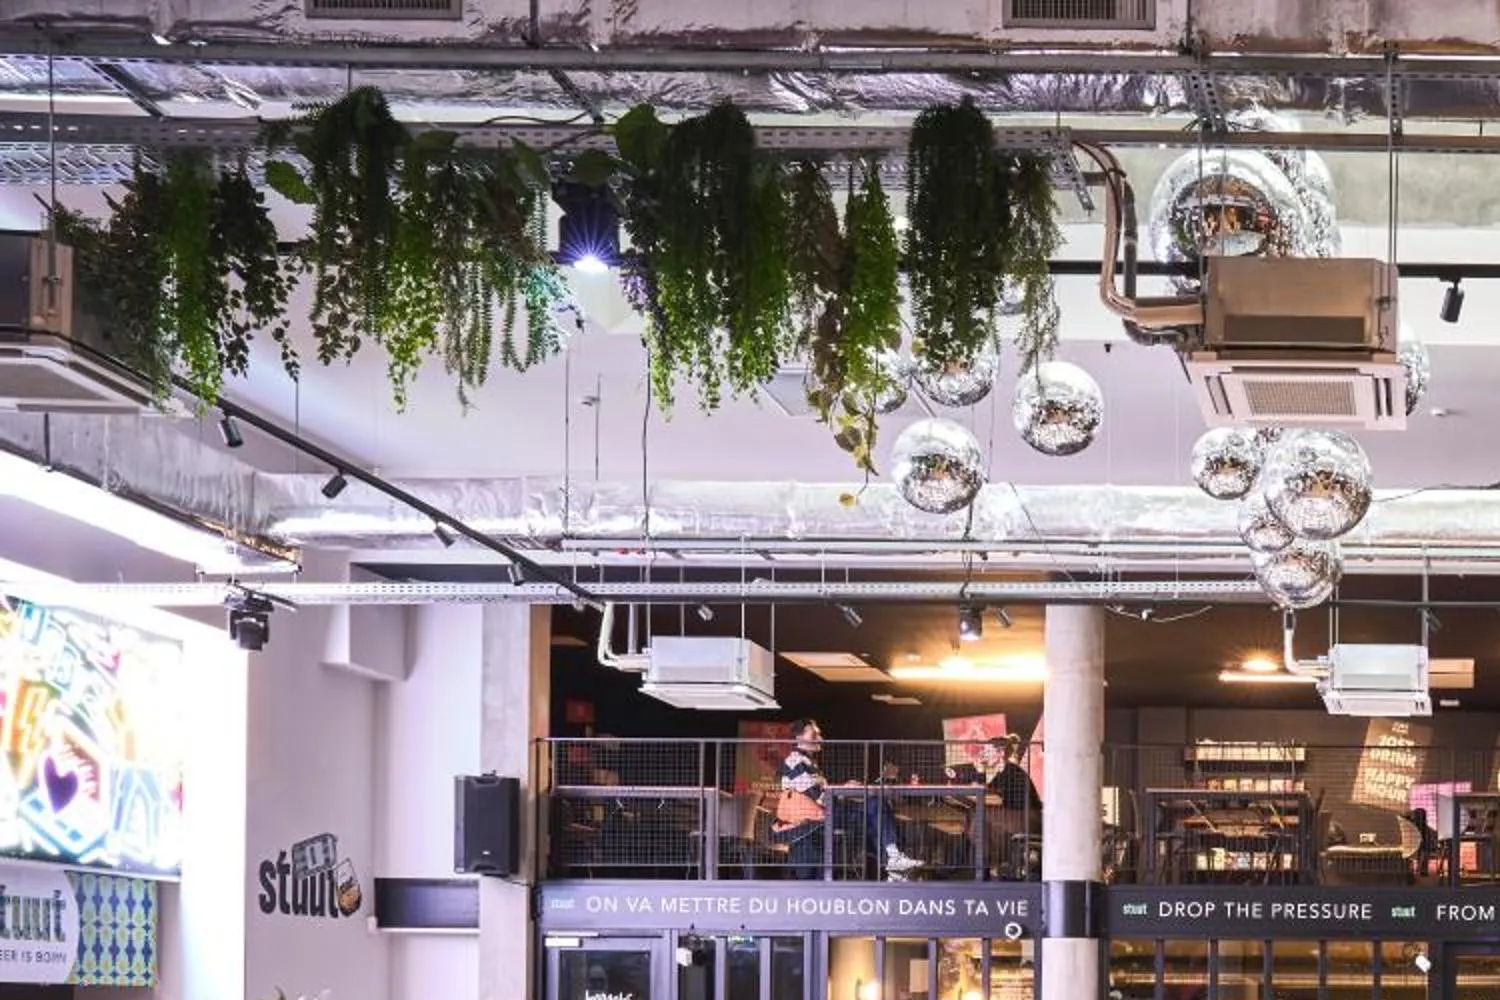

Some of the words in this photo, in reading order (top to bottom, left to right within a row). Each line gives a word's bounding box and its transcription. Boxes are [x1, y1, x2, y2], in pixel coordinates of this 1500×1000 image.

[0, 885, 66, 942] tuut
[585, 895, 618, 914] ON
[626, 896, 653, 913] VA
[661, 897, 743, 914] METTRE
[749, 897, 778, 915] DU
[787, 898, 889, 916] HOUBLON
[899, 898, 956, 916] DANS
[964, 899, 990, 916] TA
[997, 899, 1029, 917] VIE
[1158, 901, 1216, 918] DROP
[1224, 902, 1263, 919] THE
[1271, 902, 1373, 920] PRESSURE
[1437, 904, 1495, 921] FROM
